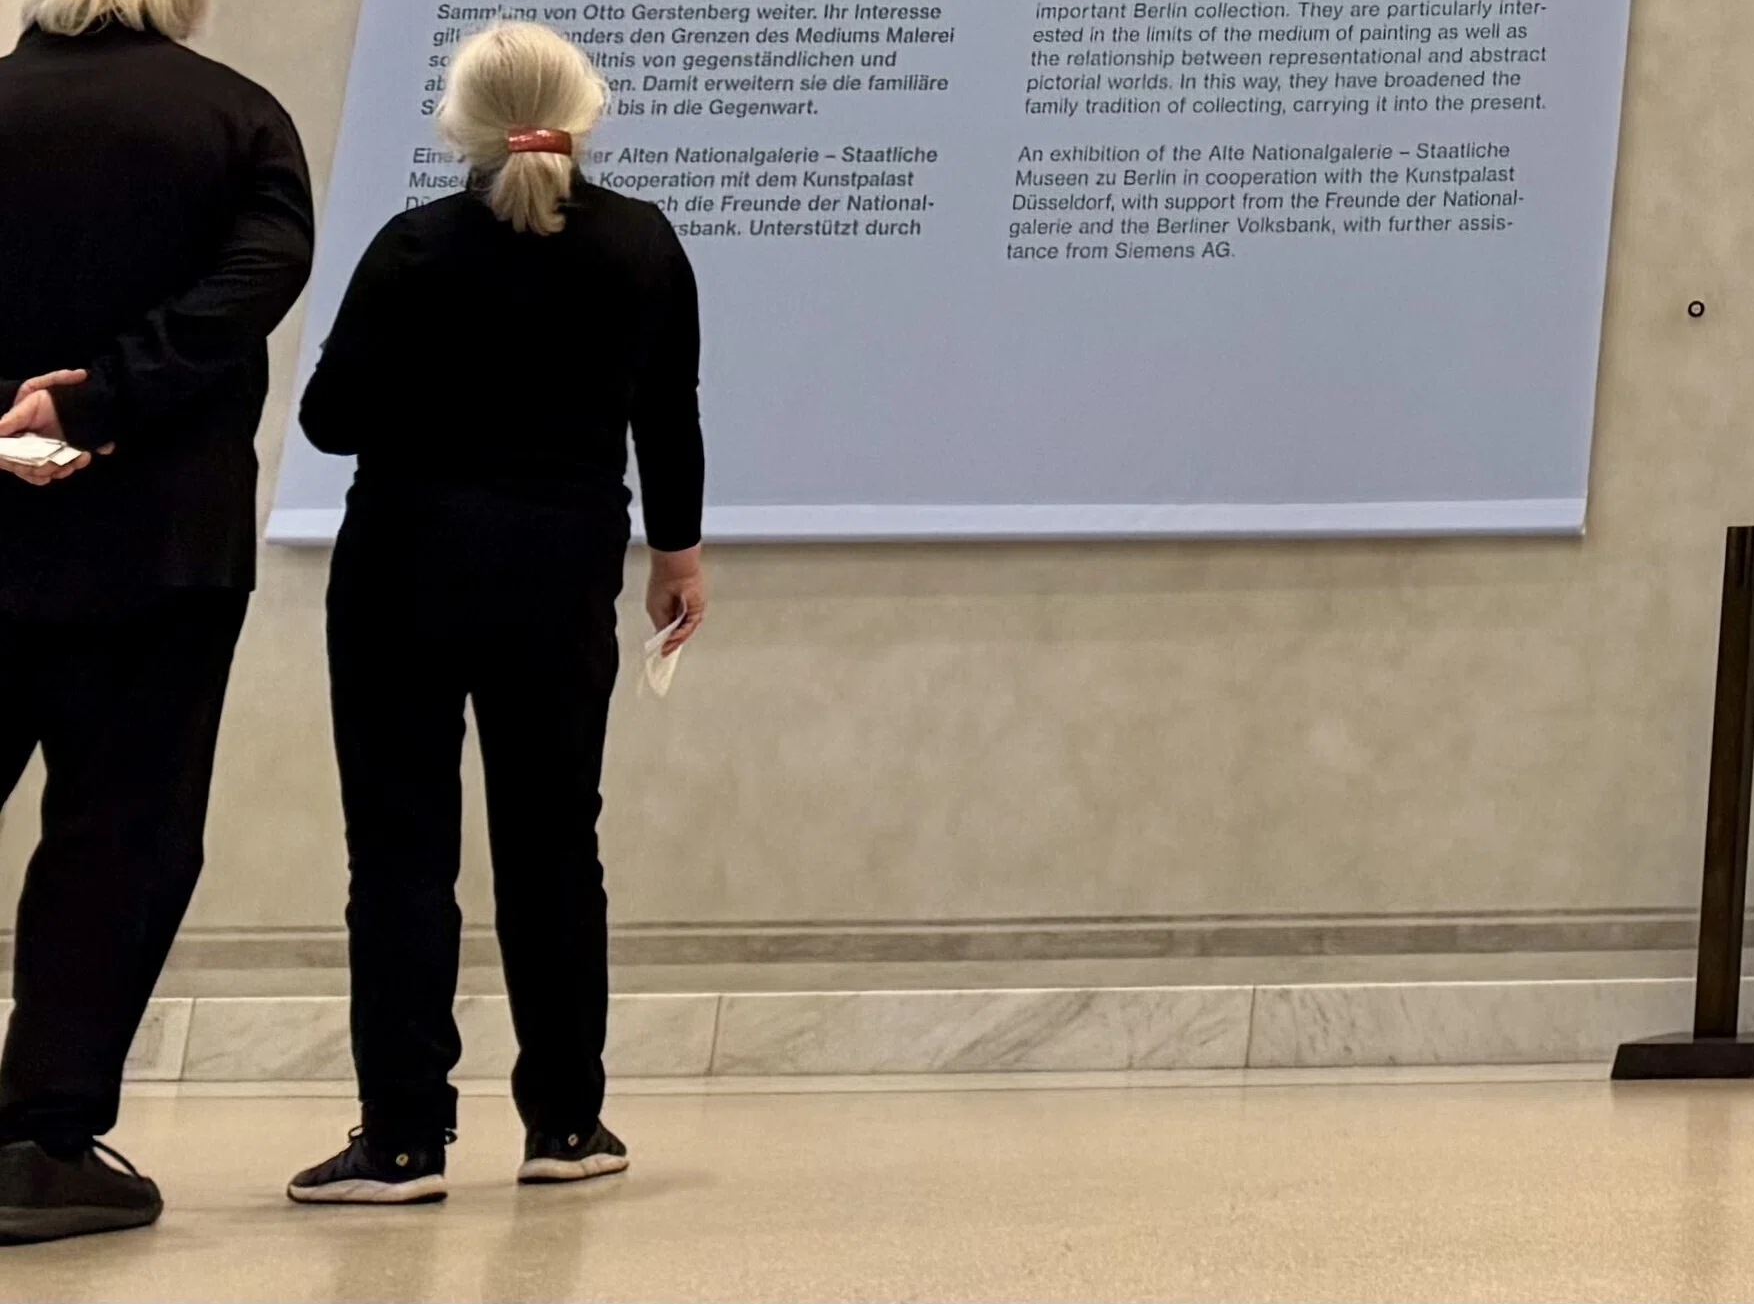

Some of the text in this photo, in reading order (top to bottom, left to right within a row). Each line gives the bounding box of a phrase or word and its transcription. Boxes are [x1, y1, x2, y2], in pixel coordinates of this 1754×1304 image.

[543, 3, 942, 24] von Otto Gerstenberg weiter. Ihr Interesse
[1030, 46, 1547, 70] the relationship between representational and abstract
[642, 73, 949, 92] Damit erweitern sie die familiäre
[601, 170, 915, 191] Kooperation mit dem Kunstpalast
[1015, 165, 1515, 189] Museen zu Berlin in cooperation with the Kunstpalast
[684, 194, 935, 213] die Freunde der National-
